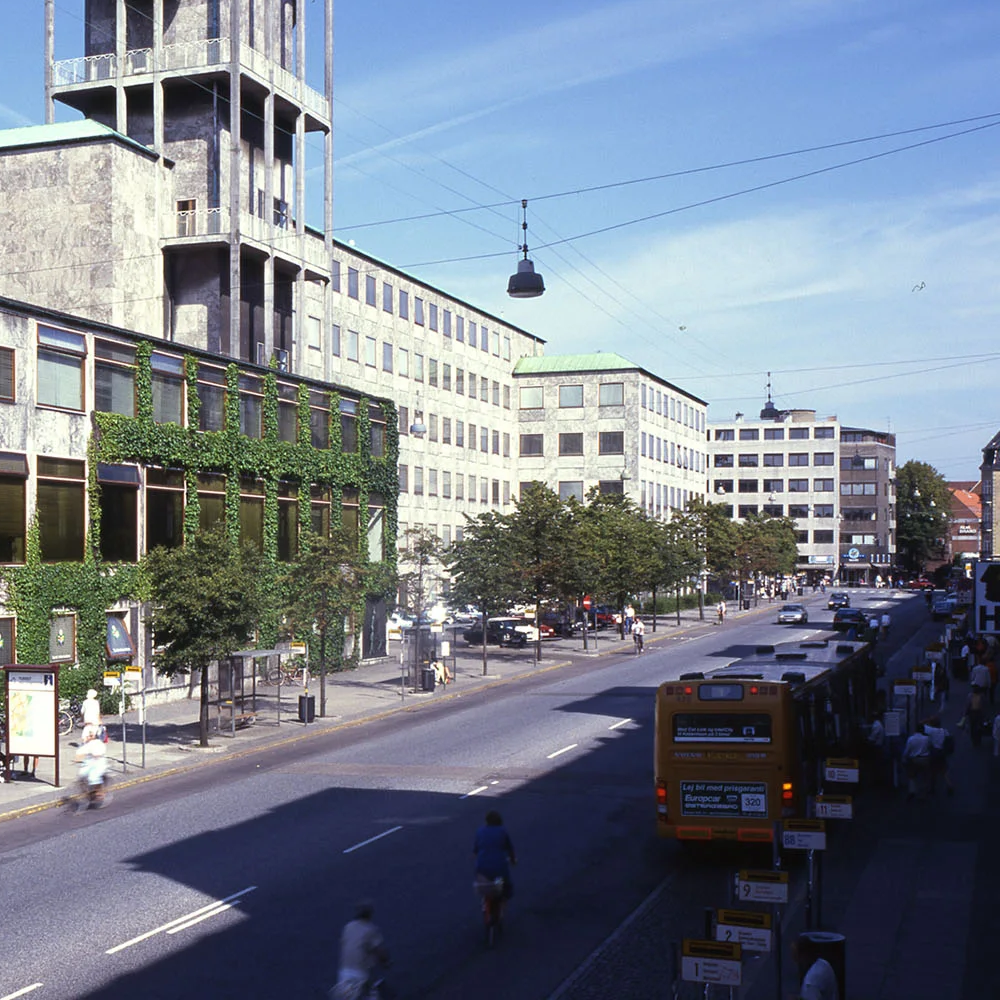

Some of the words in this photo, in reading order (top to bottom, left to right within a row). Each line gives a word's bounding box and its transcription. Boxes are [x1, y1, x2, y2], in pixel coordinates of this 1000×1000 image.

[682, 784, 694, 792] Lej
[723, 785, 765, 793] prisgaranti
[684, 794, 721, 803] Europcar
[745, 798, 761, 806] 320
[820, 805, 828, 814] 11
[743, 884, 751, 896] 9
[694, 963, 699, 976] 1
